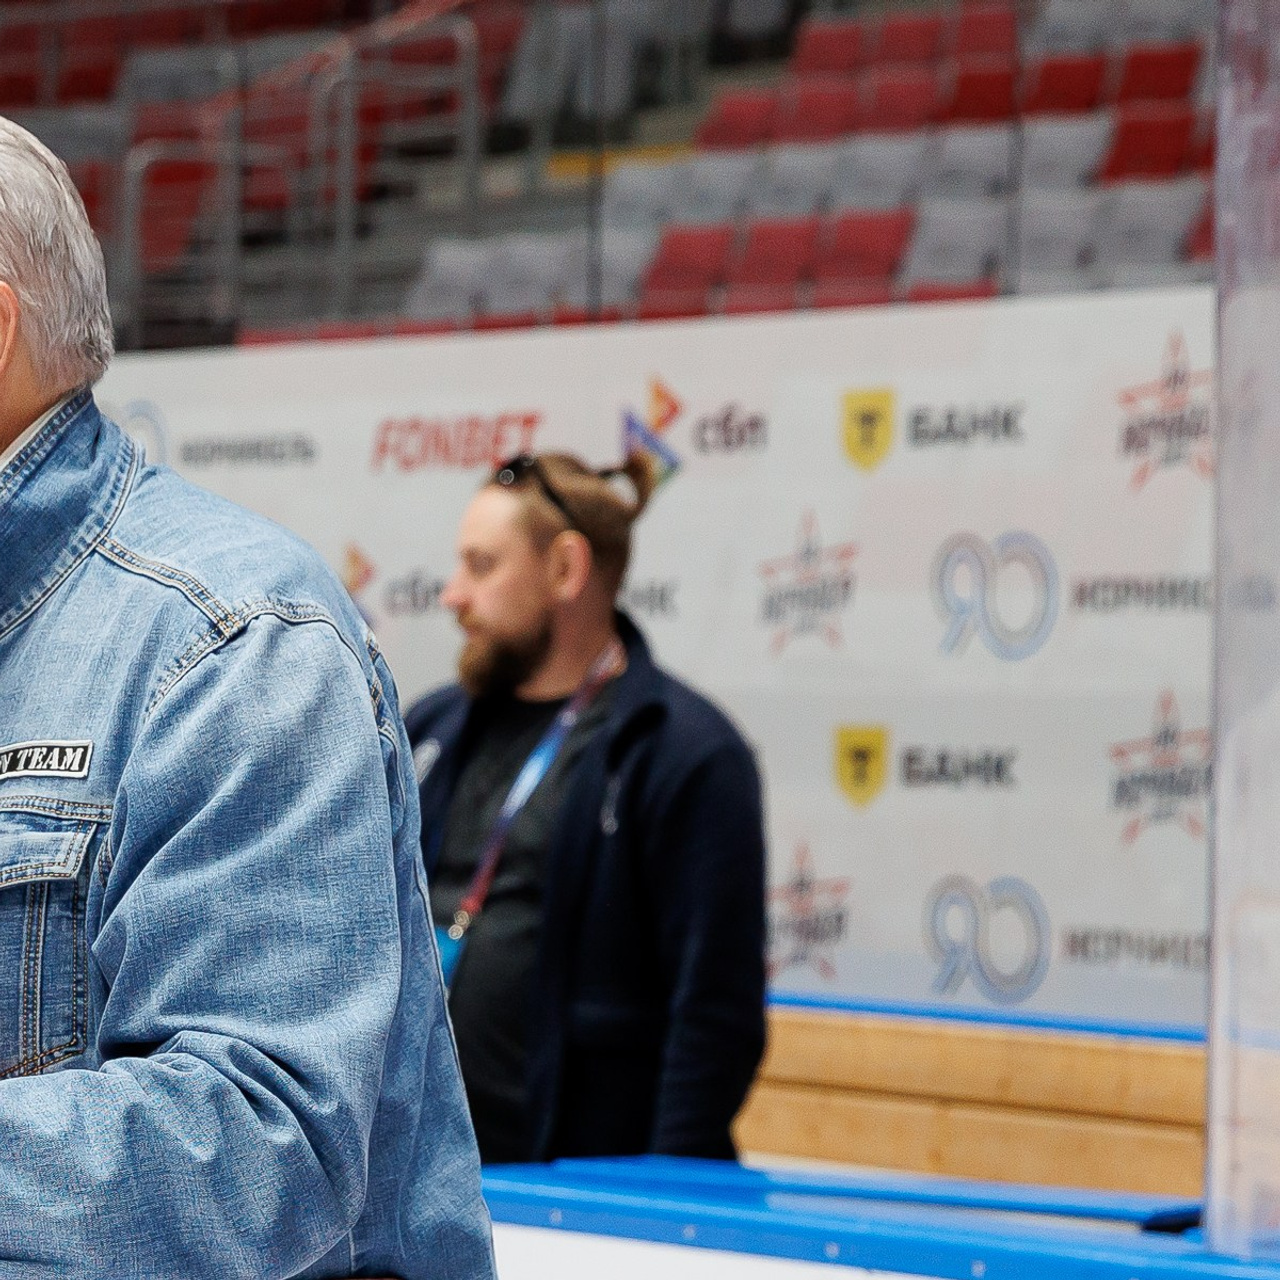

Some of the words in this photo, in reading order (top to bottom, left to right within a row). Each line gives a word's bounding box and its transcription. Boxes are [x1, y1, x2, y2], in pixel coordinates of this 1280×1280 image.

[909, 405, 1023, 447] БАНК
[15, 747, 85, 772] TEAM
[899, 743, 1015, 787] БАНК
